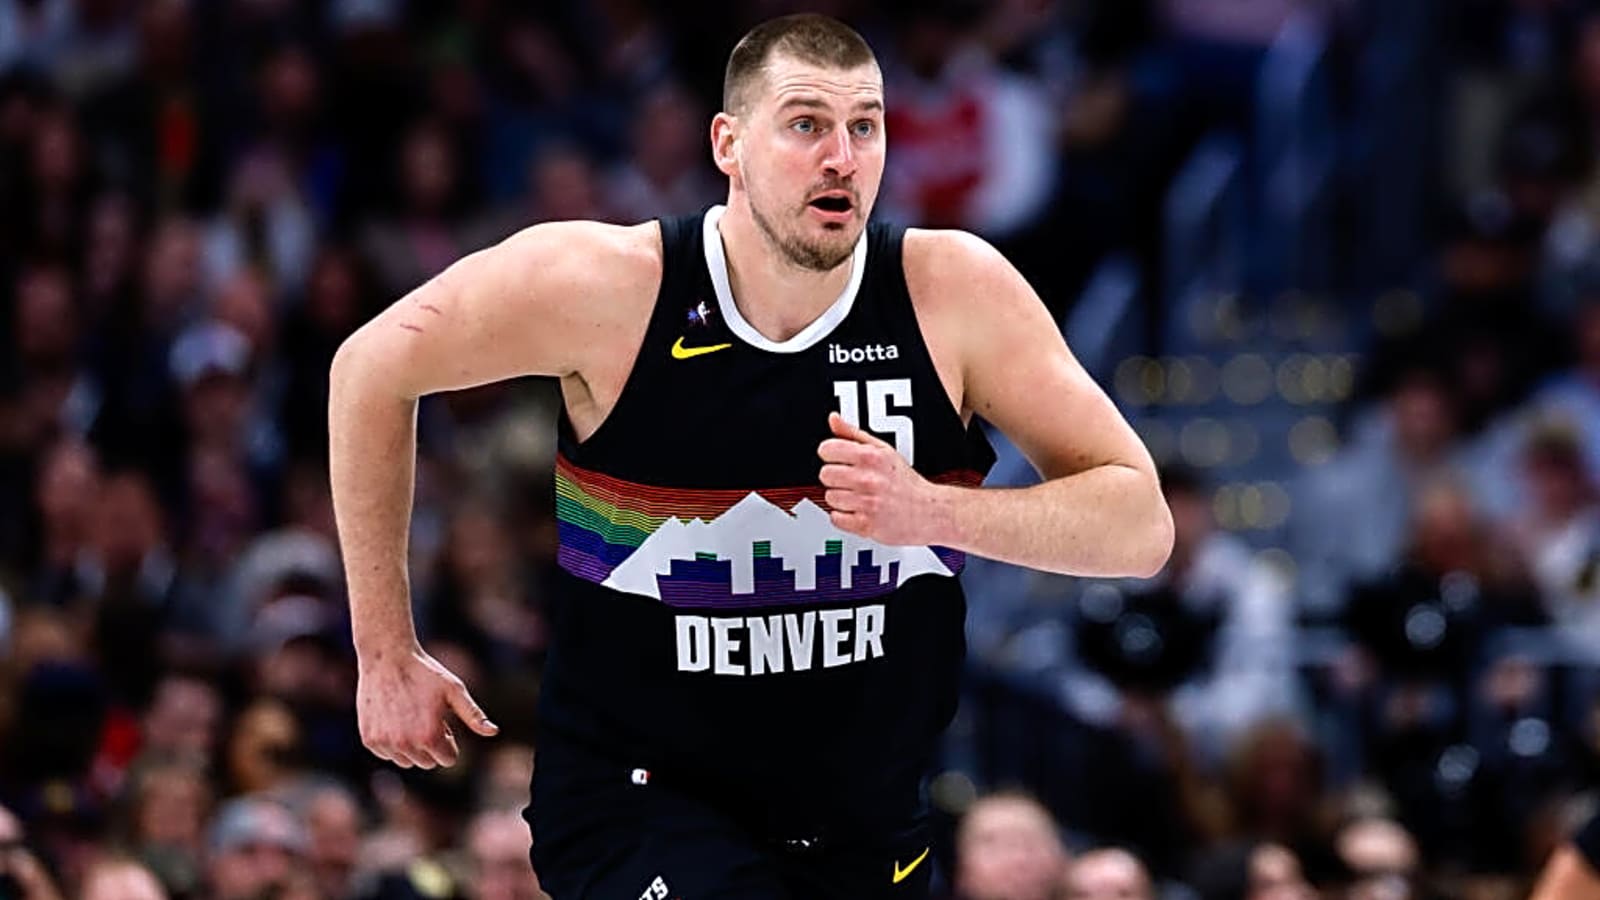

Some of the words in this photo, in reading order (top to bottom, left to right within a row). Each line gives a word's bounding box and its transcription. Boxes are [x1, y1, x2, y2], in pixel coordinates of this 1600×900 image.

[828, 343, 899, 363] ibotta
[833, 378, 914, 467] 15
[675, 604, 885, 676] DENVER
